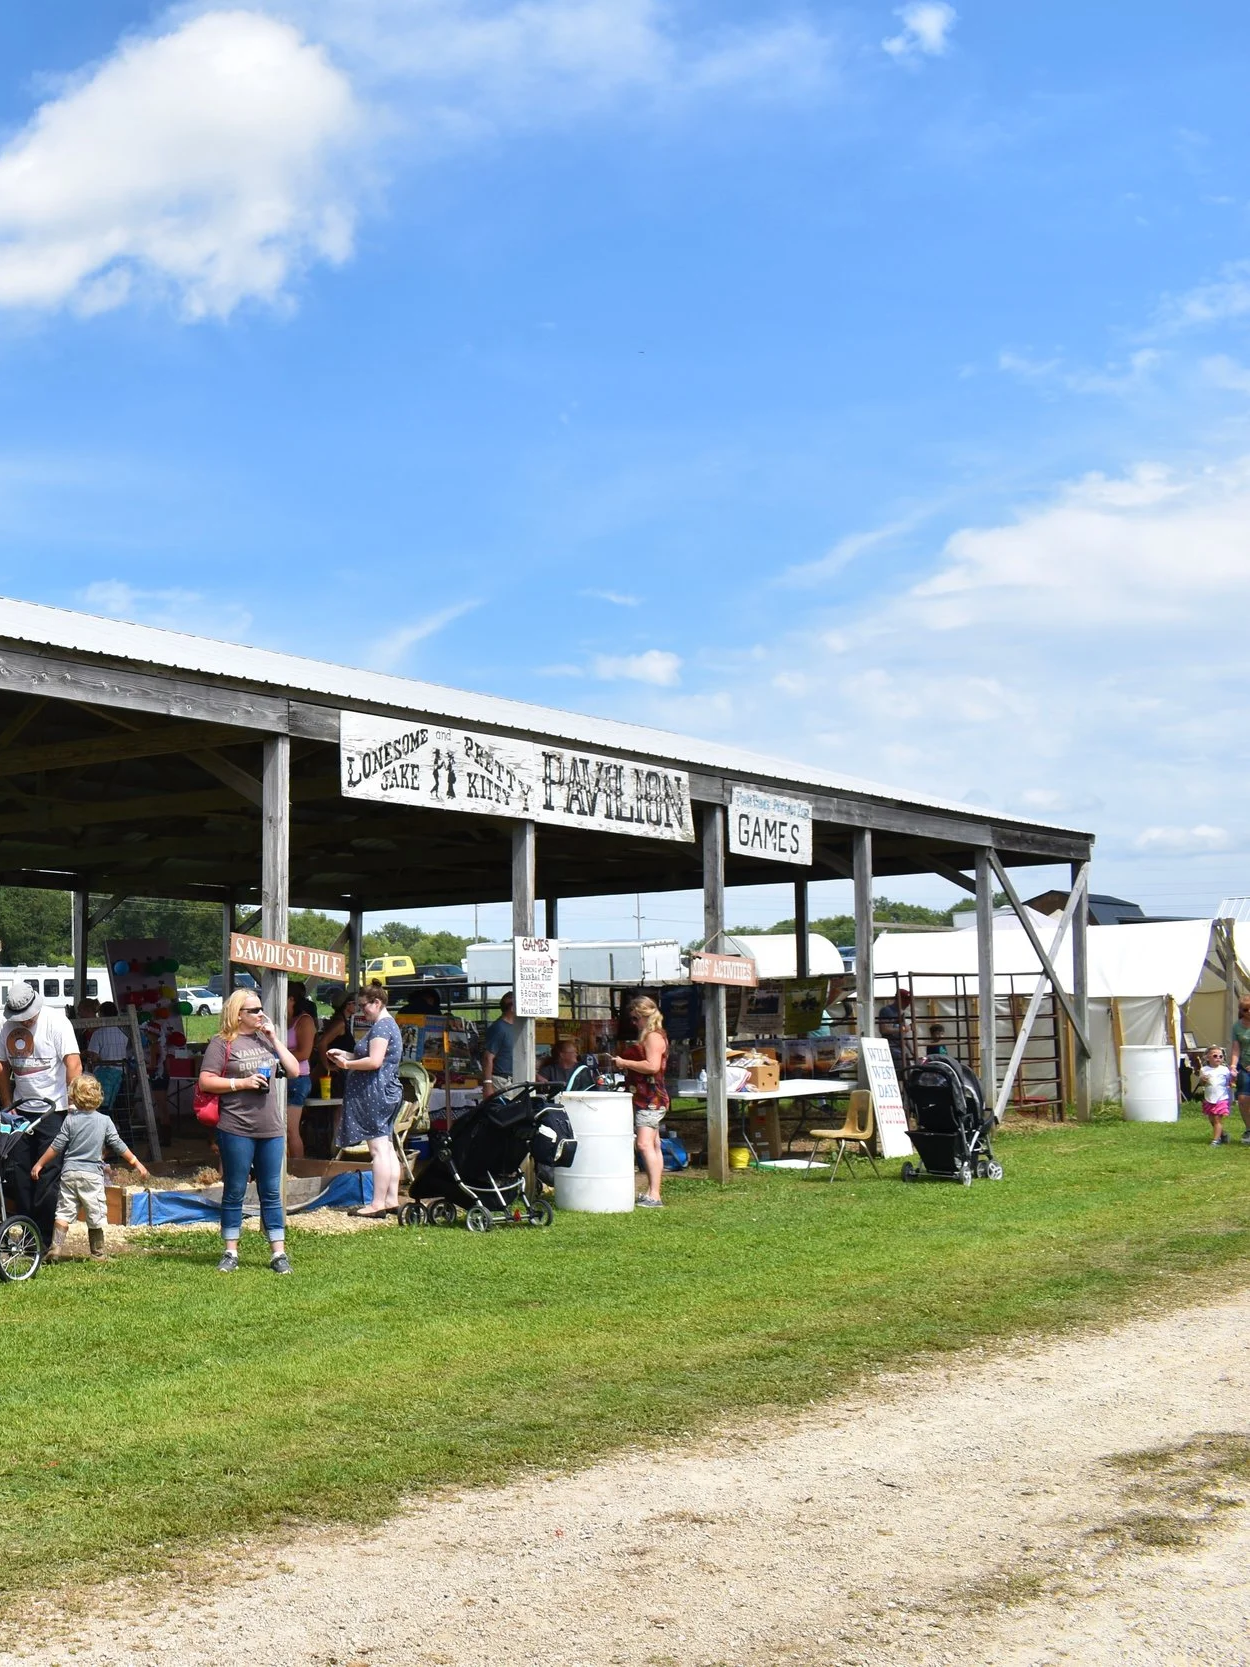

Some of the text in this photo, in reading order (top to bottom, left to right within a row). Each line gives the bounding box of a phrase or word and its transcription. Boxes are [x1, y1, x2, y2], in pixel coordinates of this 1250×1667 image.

[436, 729, 451, 741] and
[347, 729, 428, 787] LONESOME
[381, 764, 419, 791] JAKE
[464, 736, 531, 812] PRETTY
[467, 772, 511, 805] KITTY
[542, 751, 684, 828] PAVILION
[739, 814, 799, 854] GAMES
[236, 938, 341, 976] SAWDUST PILE
[522, 938, 549, 952] GAMES
[867, 1048, 891, 1062] WILD
[871, 1065, 896, 1080] WEST
[877, 1085, 899, 1098] DAYS
